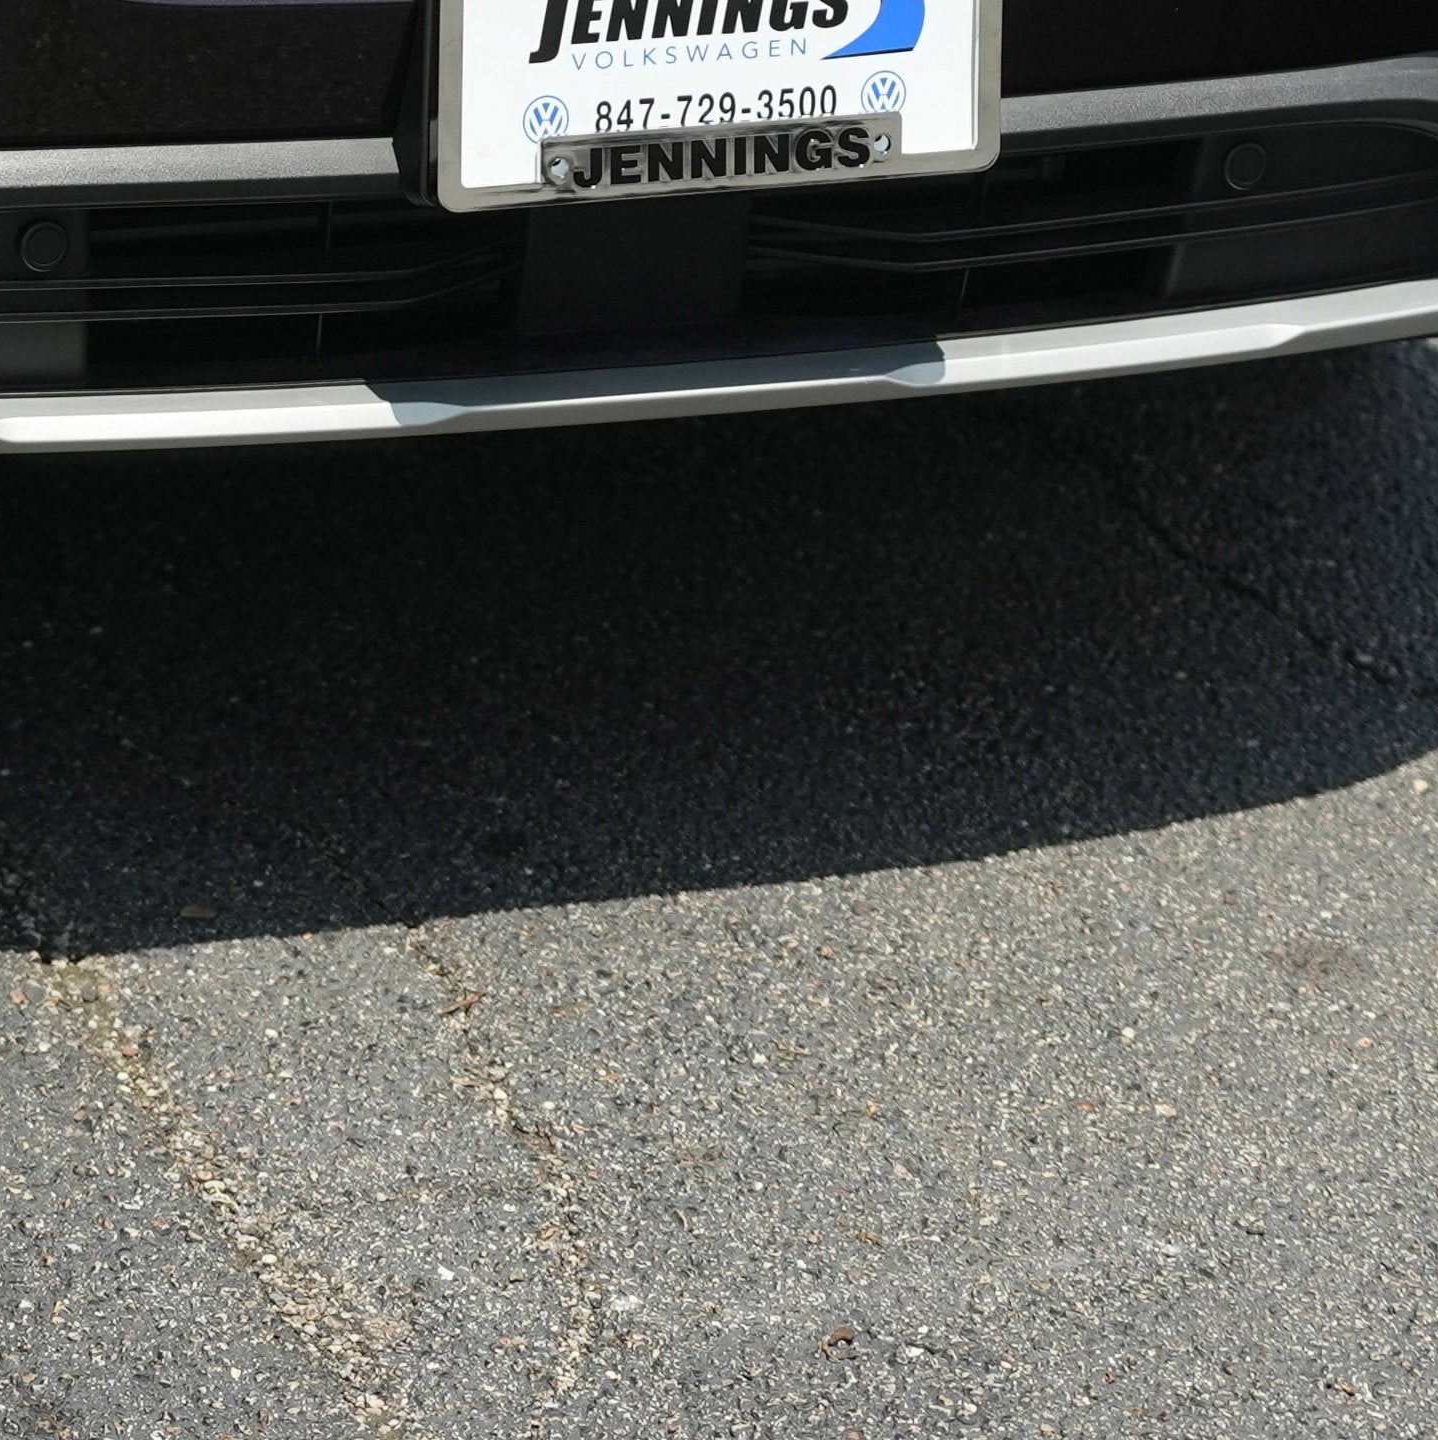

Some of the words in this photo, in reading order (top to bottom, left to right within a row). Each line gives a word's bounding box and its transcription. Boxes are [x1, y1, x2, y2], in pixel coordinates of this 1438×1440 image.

[572, 37, 808, 71] VOLKSWAGEN
[595, 84, 838, 133] 847-729-3500
[573, 126, 872, 189] JENNINGS
